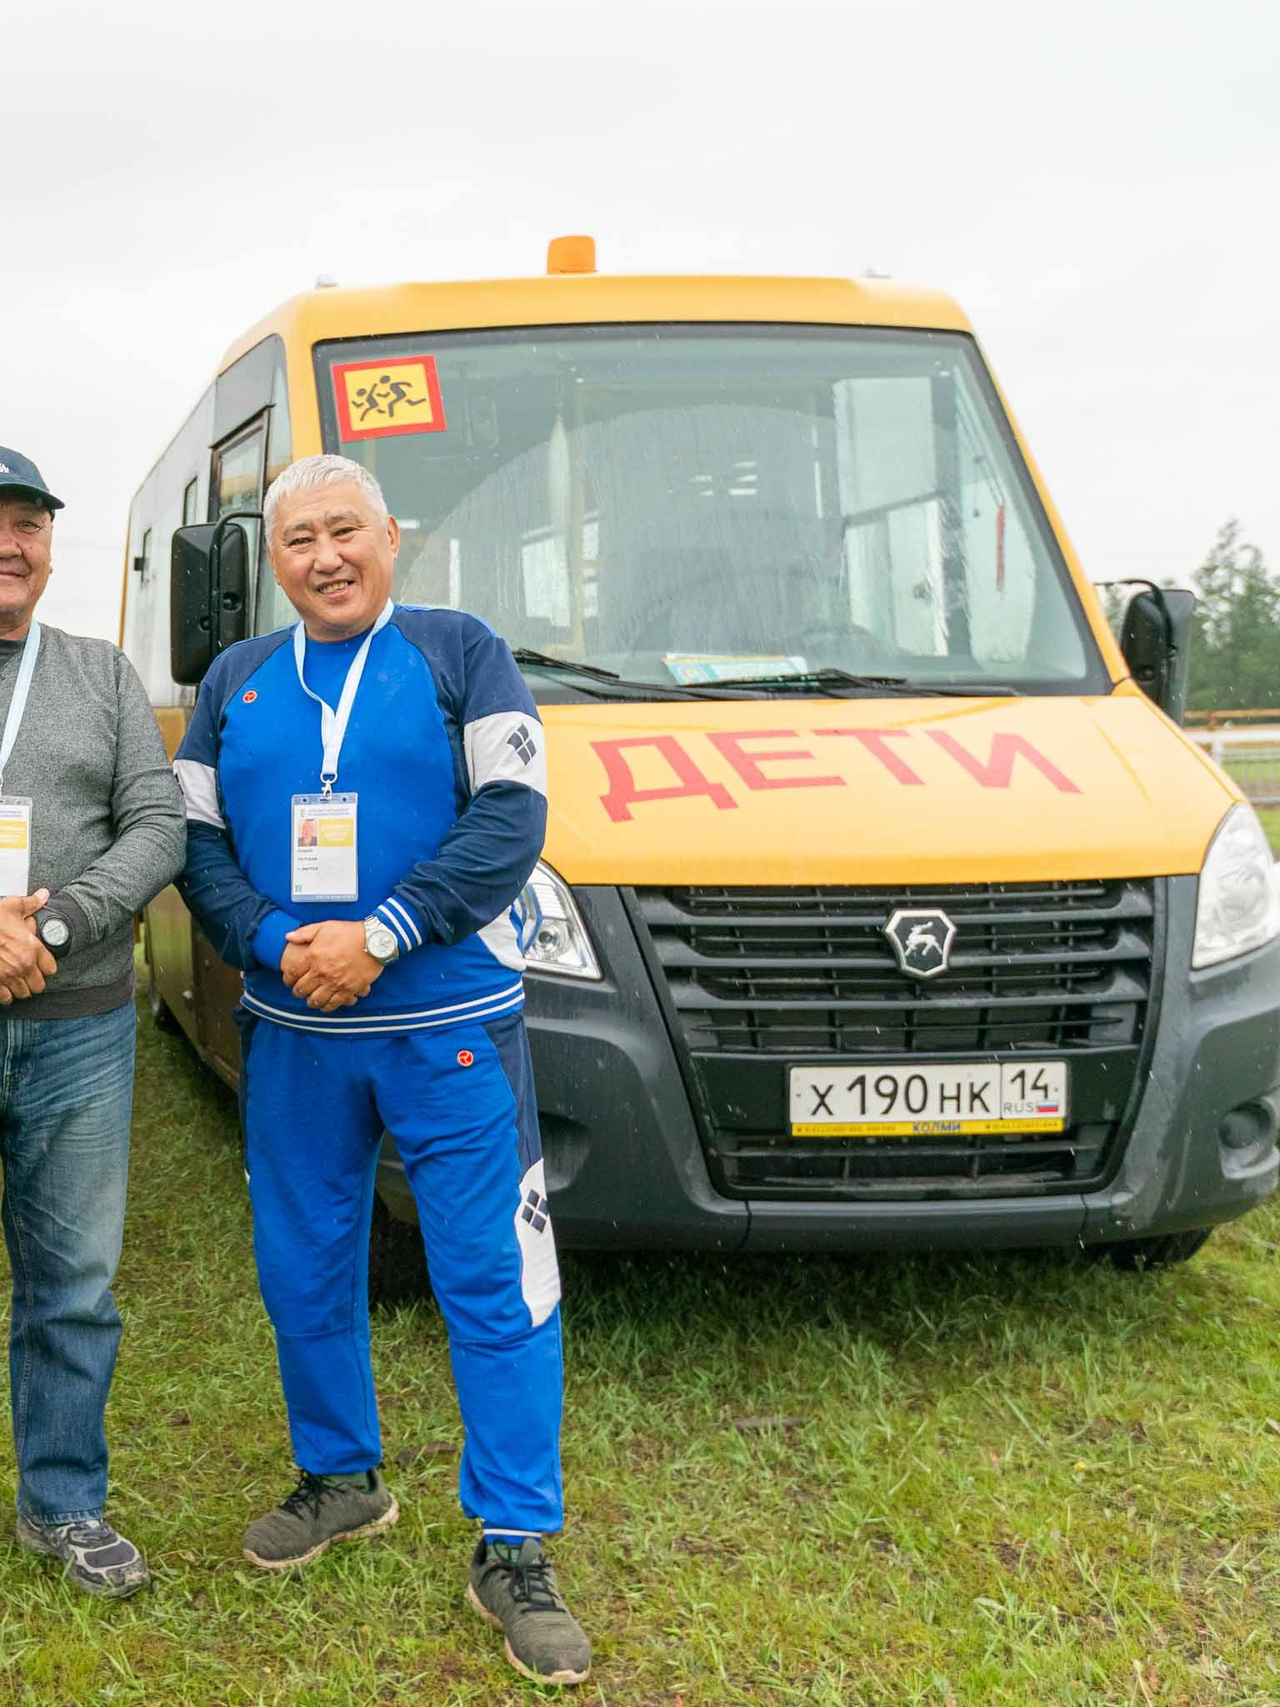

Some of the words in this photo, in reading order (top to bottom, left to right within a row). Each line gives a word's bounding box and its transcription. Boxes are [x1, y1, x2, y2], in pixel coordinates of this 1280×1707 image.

[589, 729, 1084, 823] ДЕТИ
[1010, 1068, 1049, 1100] 14
[1004, 1102, 1034, 1113] RUS
